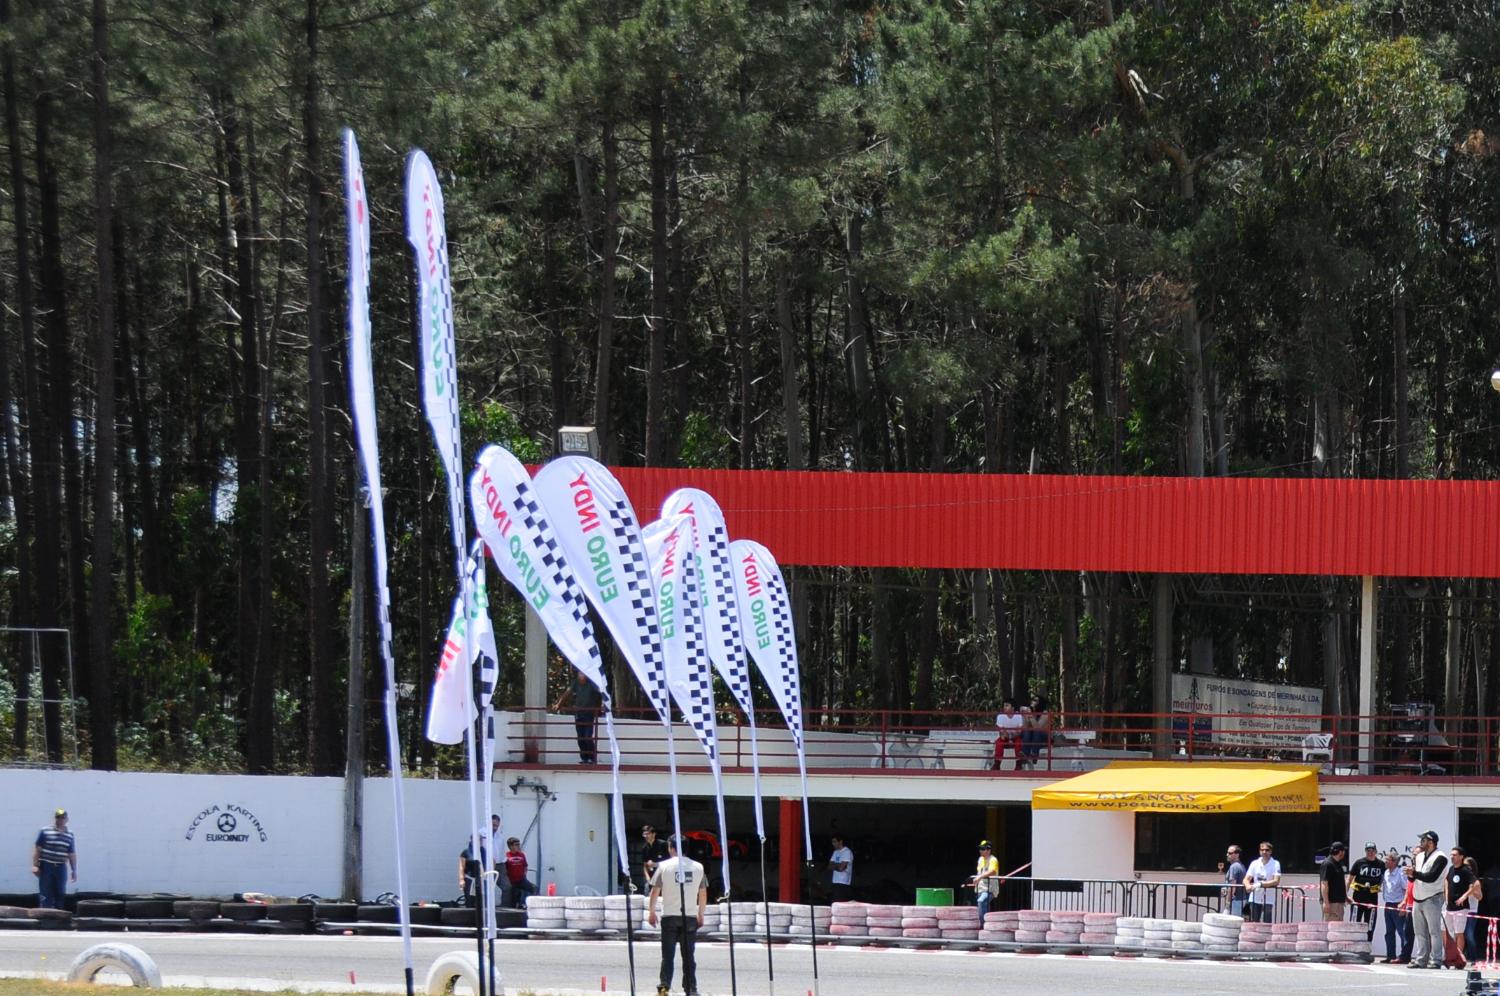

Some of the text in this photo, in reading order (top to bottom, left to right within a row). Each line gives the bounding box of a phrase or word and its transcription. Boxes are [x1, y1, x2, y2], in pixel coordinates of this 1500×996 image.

[185, 803, 268, 842] ESCOLA KARTING
[206, 833, 250, 842] EUROINDY
